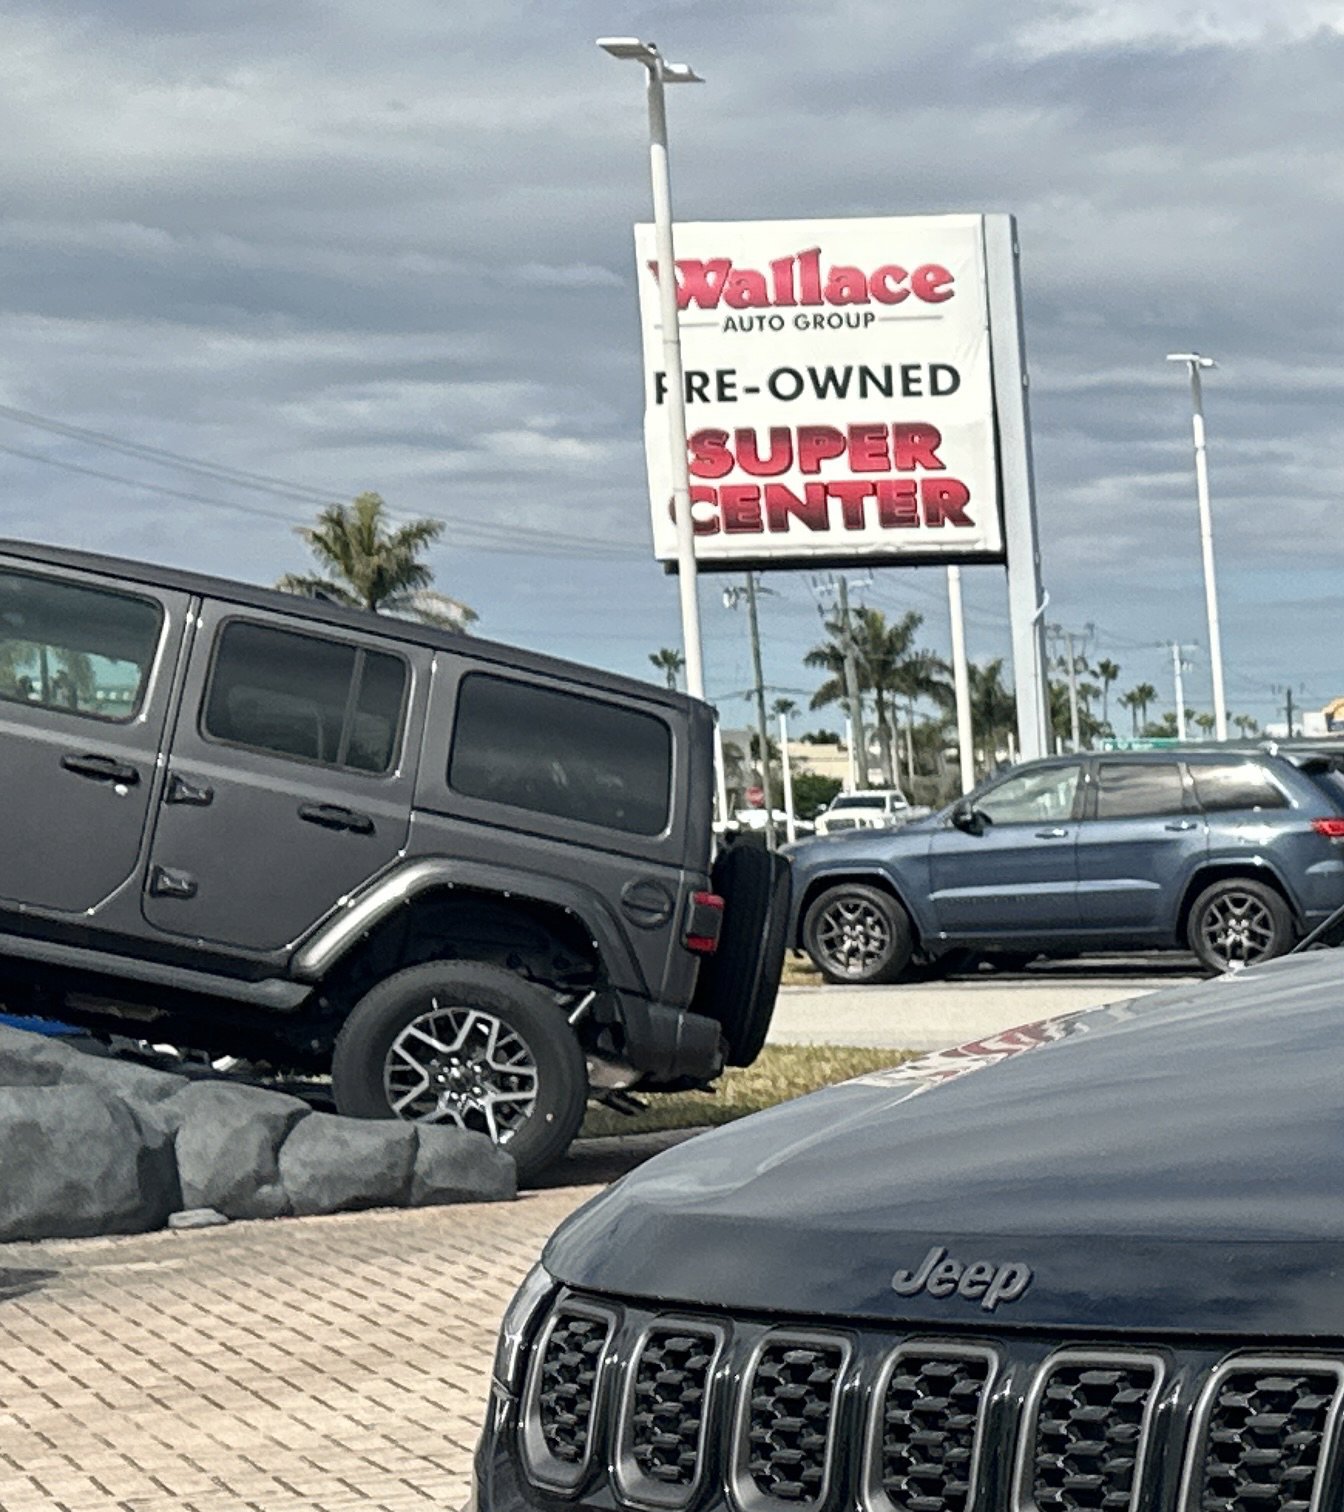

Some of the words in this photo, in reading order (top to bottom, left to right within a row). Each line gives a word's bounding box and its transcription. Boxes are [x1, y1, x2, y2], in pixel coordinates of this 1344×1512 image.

[647, 246, 955, 310] Wallace
[723, 315, 785, 333] AUTO
[794, 311, 876, 331] GROUP
[687, 421, 947, 479] SUPER
[669, 476, 976, 536] CENTER
[891, 1246, 1034, 1315] Jeep
